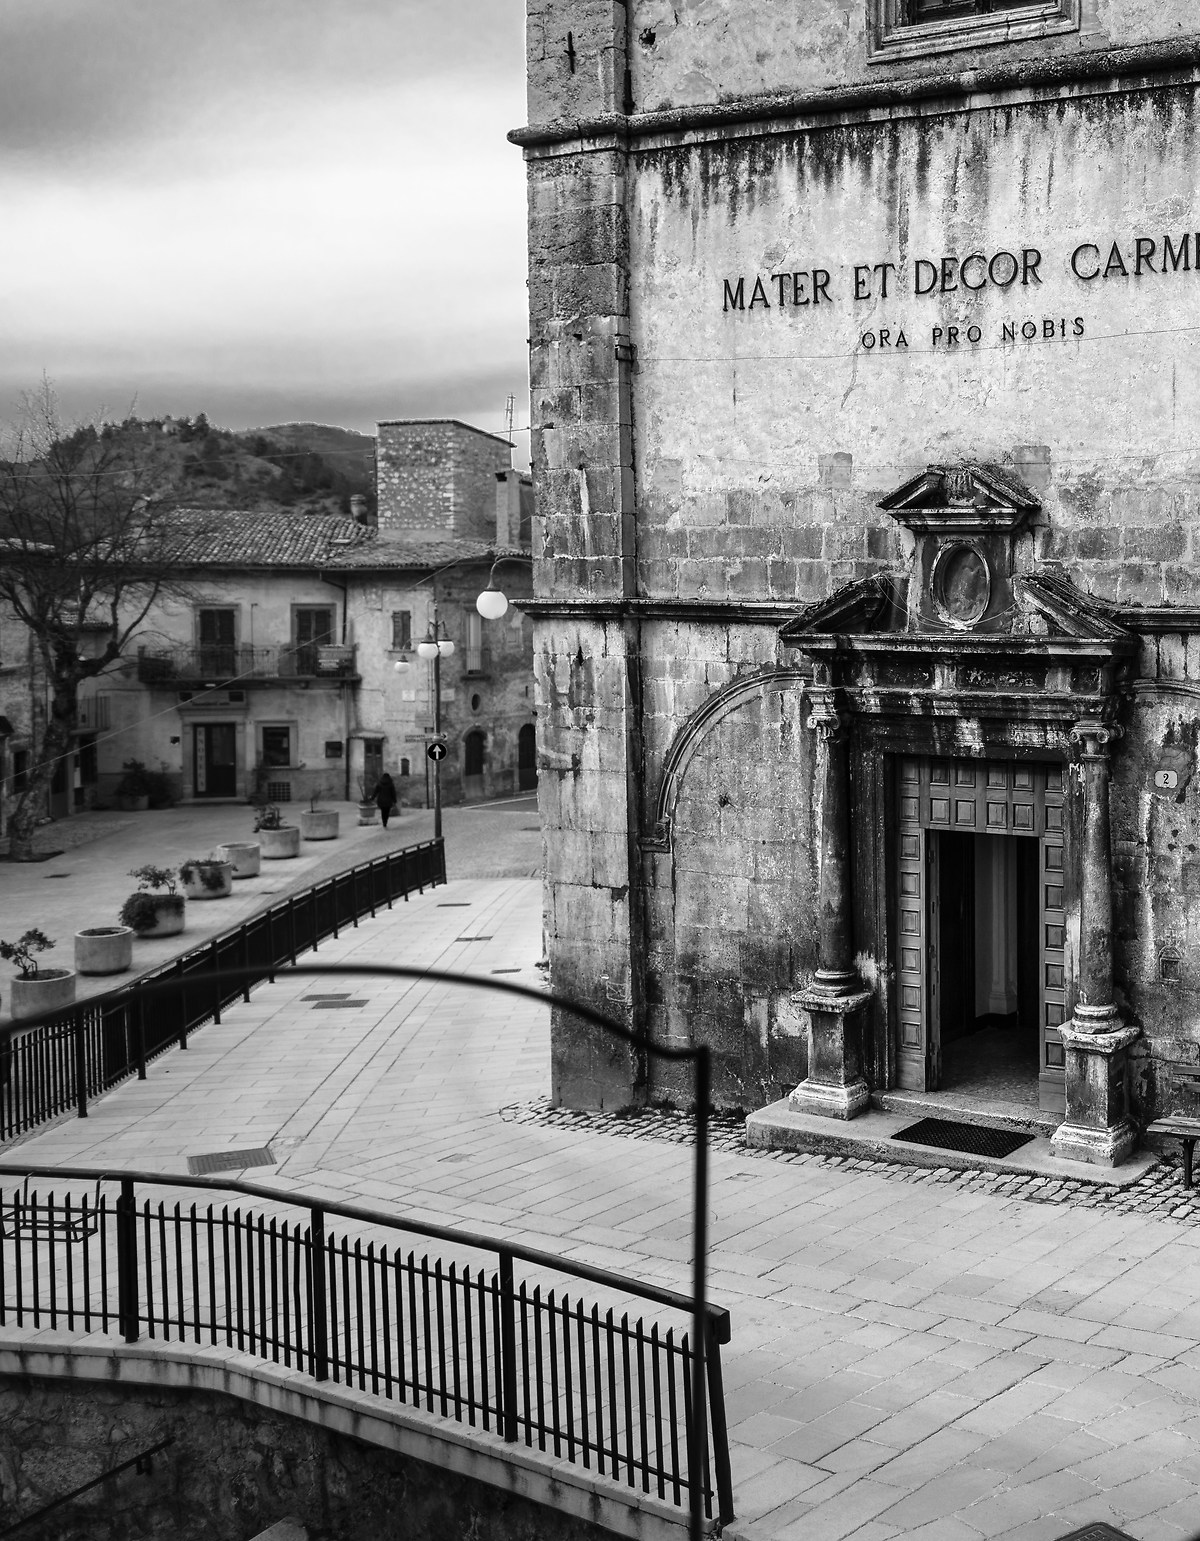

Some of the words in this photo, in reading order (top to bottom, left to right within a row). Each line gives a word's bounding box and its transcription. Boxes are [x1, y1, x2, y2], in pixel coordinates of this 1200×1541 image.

[722, 269, 833, 312] MATER
[854, 263, 895, 300] ET
[915, 249, 1041, 294] DECOR
[862, 330, 908, 348] ORA
[933, 326, 981, 345] PRO
[1001, 317, 1084, 342] NOBIS
[1163, 773, 1170, 785] 2
